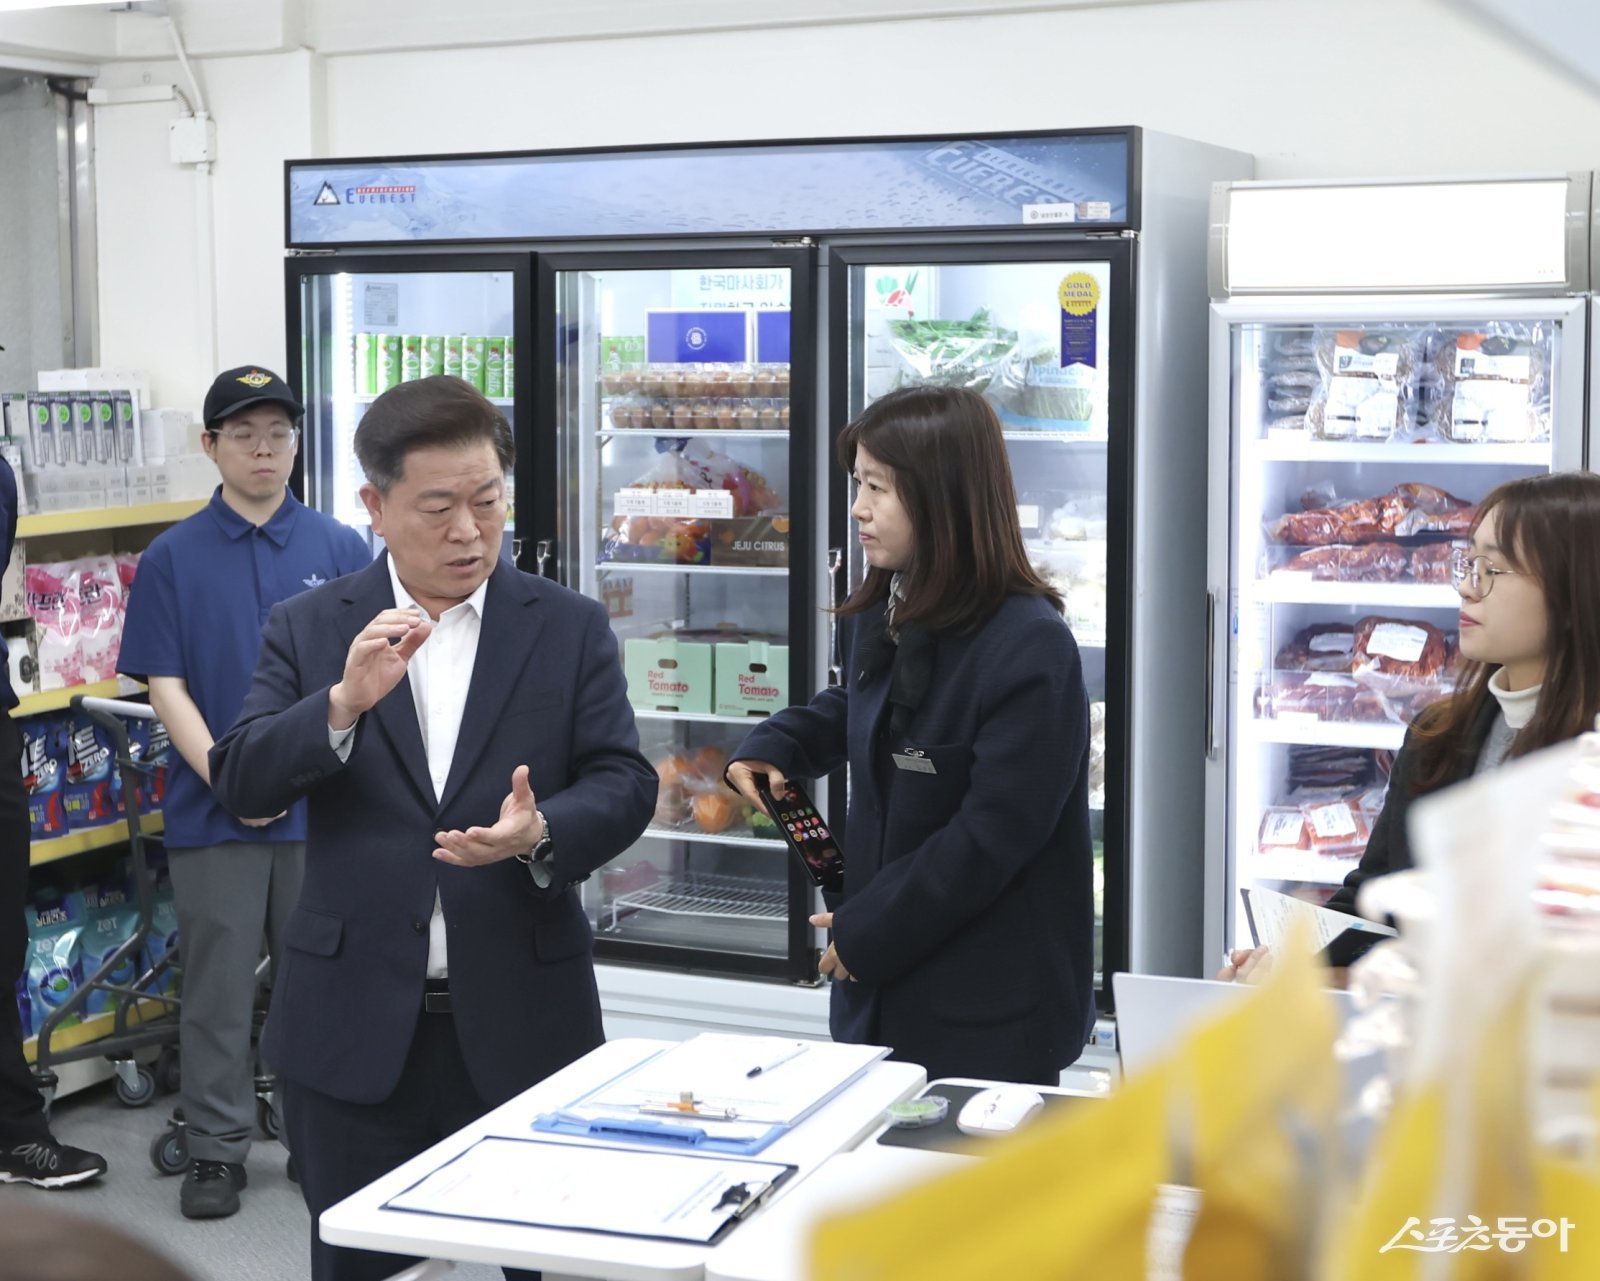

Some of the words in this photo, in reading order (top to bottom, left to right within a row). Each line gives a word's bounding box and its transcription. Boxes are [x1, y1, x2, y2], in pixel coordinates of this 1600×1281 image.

[700, 274, 783, 291] 한국마사회가
[732, 541, 752, 551] JEJU
[753, 541, 785, 551] CITRUS
[647, 670, 664, 679] Red
[738, 673, 755, 683] Red
[648, 680, 689, 694] Tomato
[738, 684, 780, 698] Tomato
[81, 746, 110, 773] ZERO
[34, 758, 58, 785] ZERO
